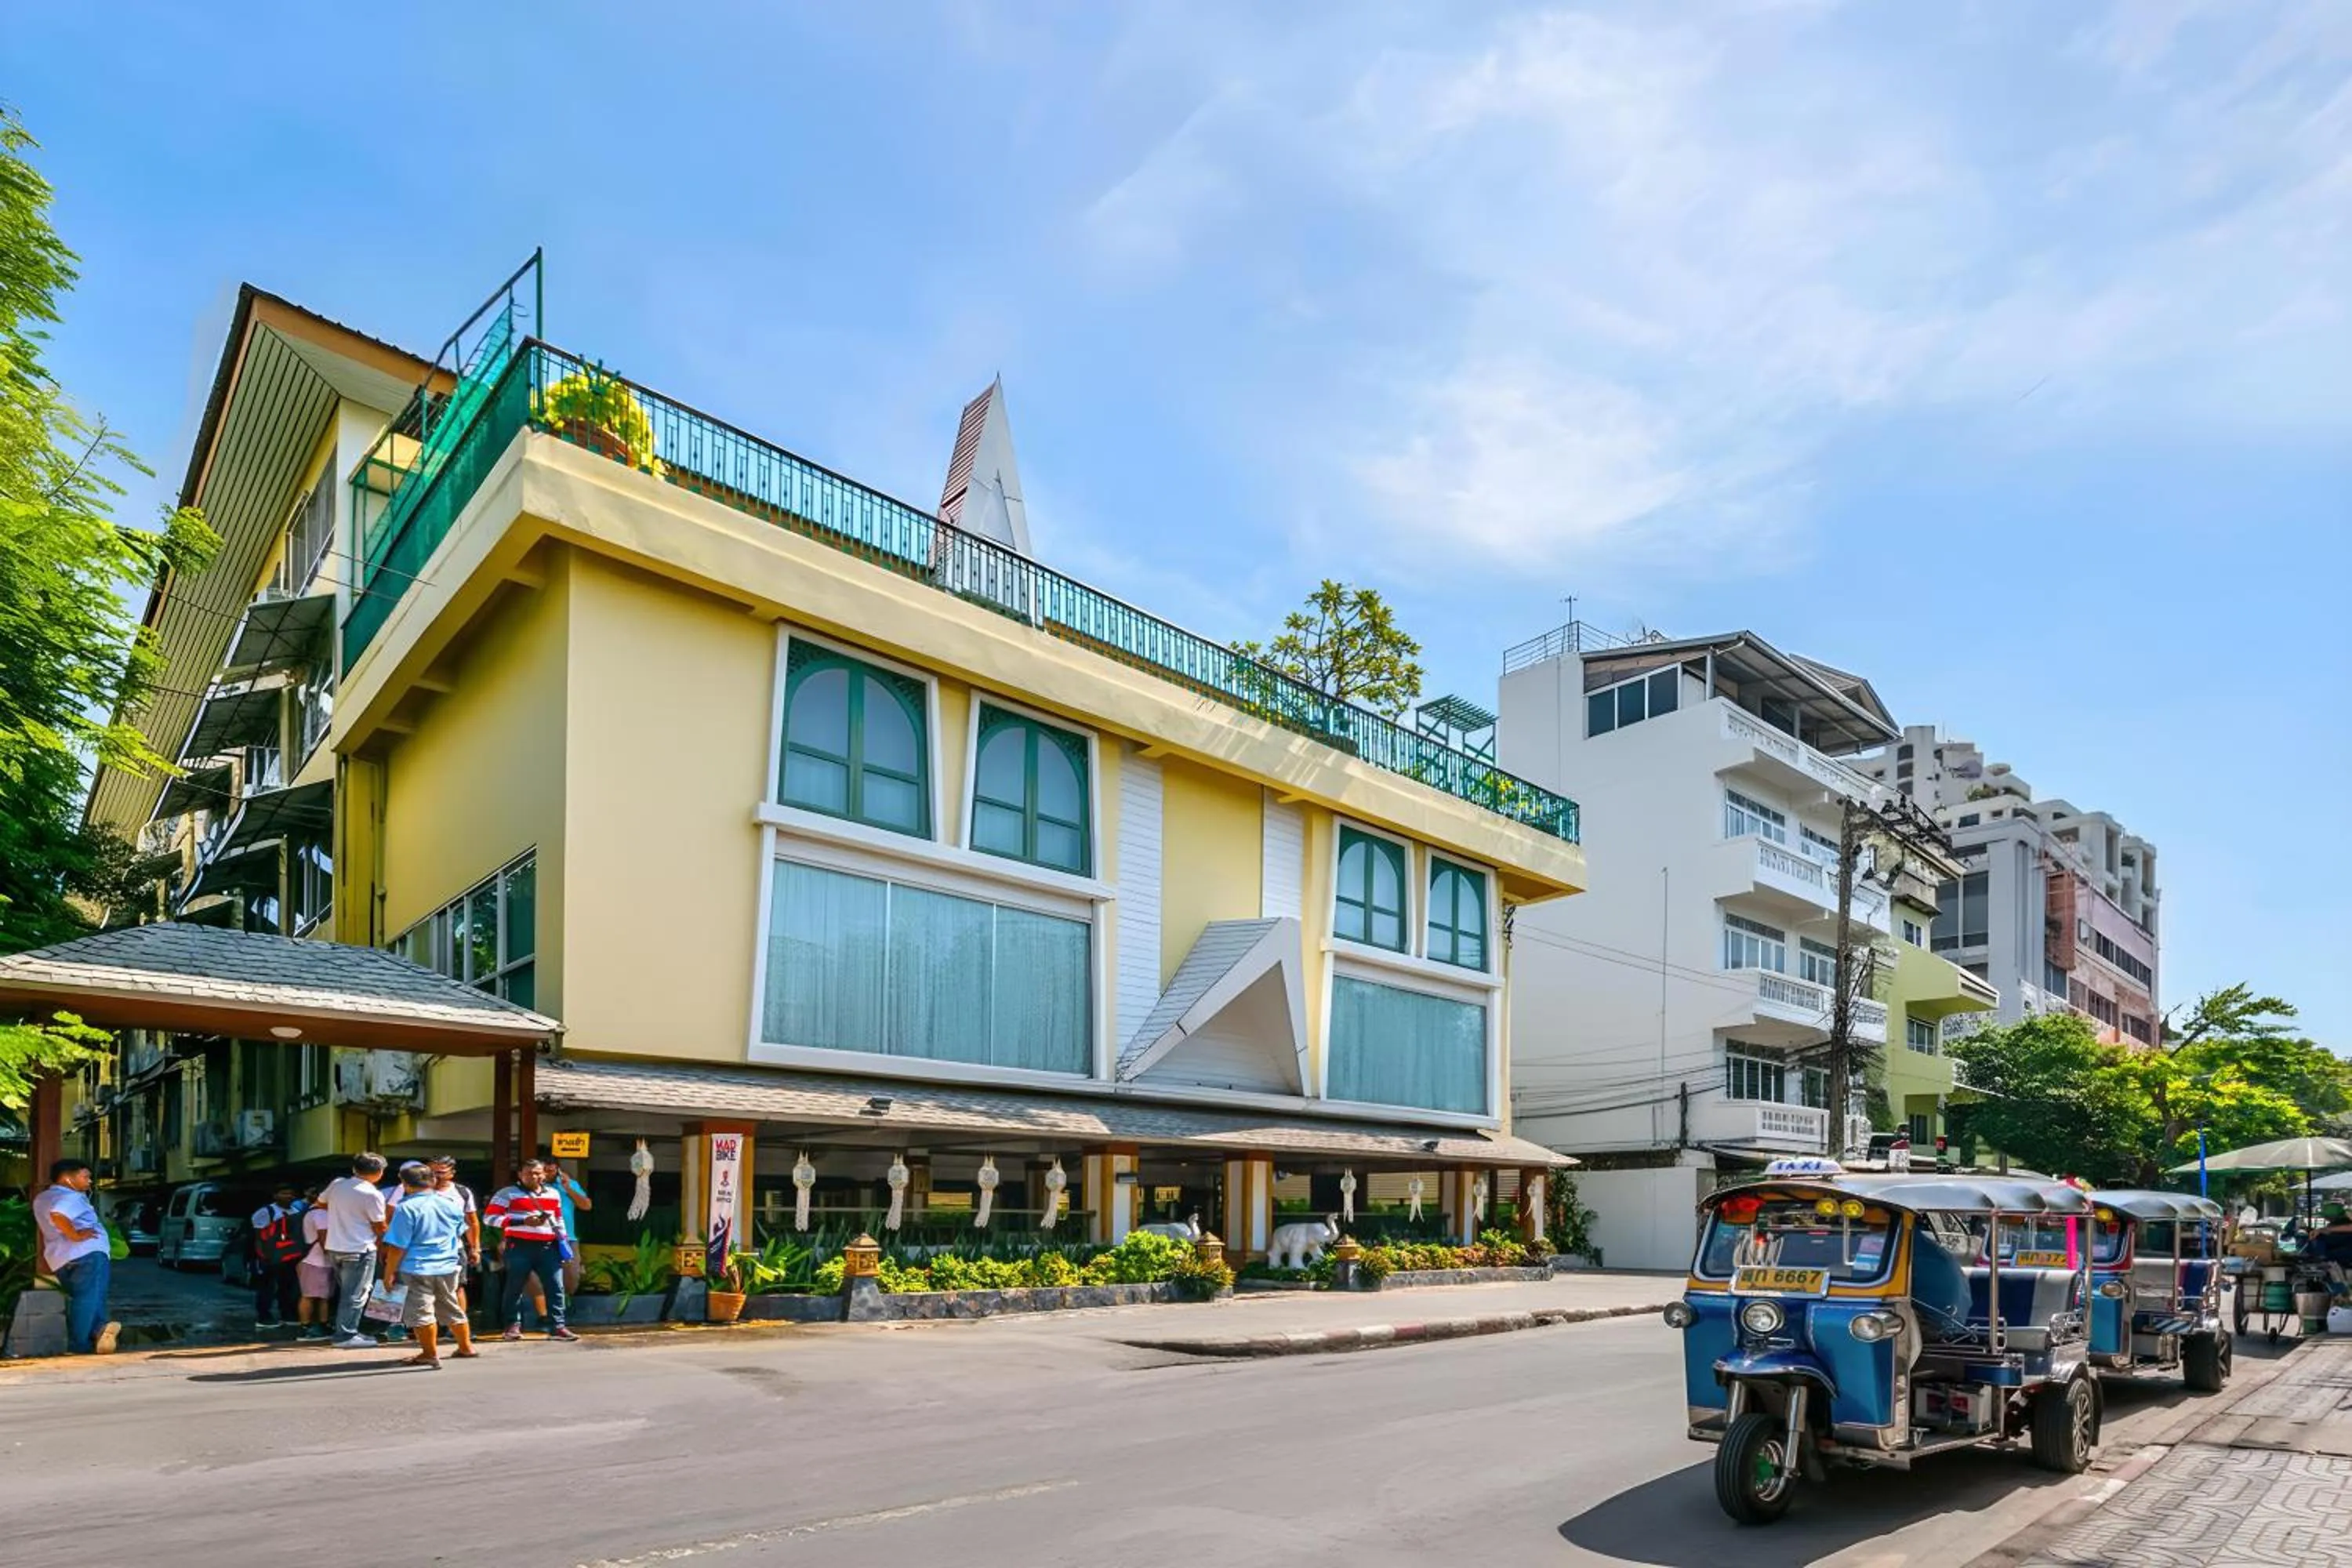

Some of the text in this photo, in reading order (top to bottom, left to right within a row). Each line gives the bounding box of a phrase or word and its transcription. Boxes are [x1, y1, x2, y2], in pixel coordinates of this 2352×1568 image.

[715, 1139, 736, 1150] MAD
[715, 1150, 736, 1161] BIKE
[1776, 1161, 1821, 1171] TAXI
[1774, 1270, 1821, 1284] 6667
